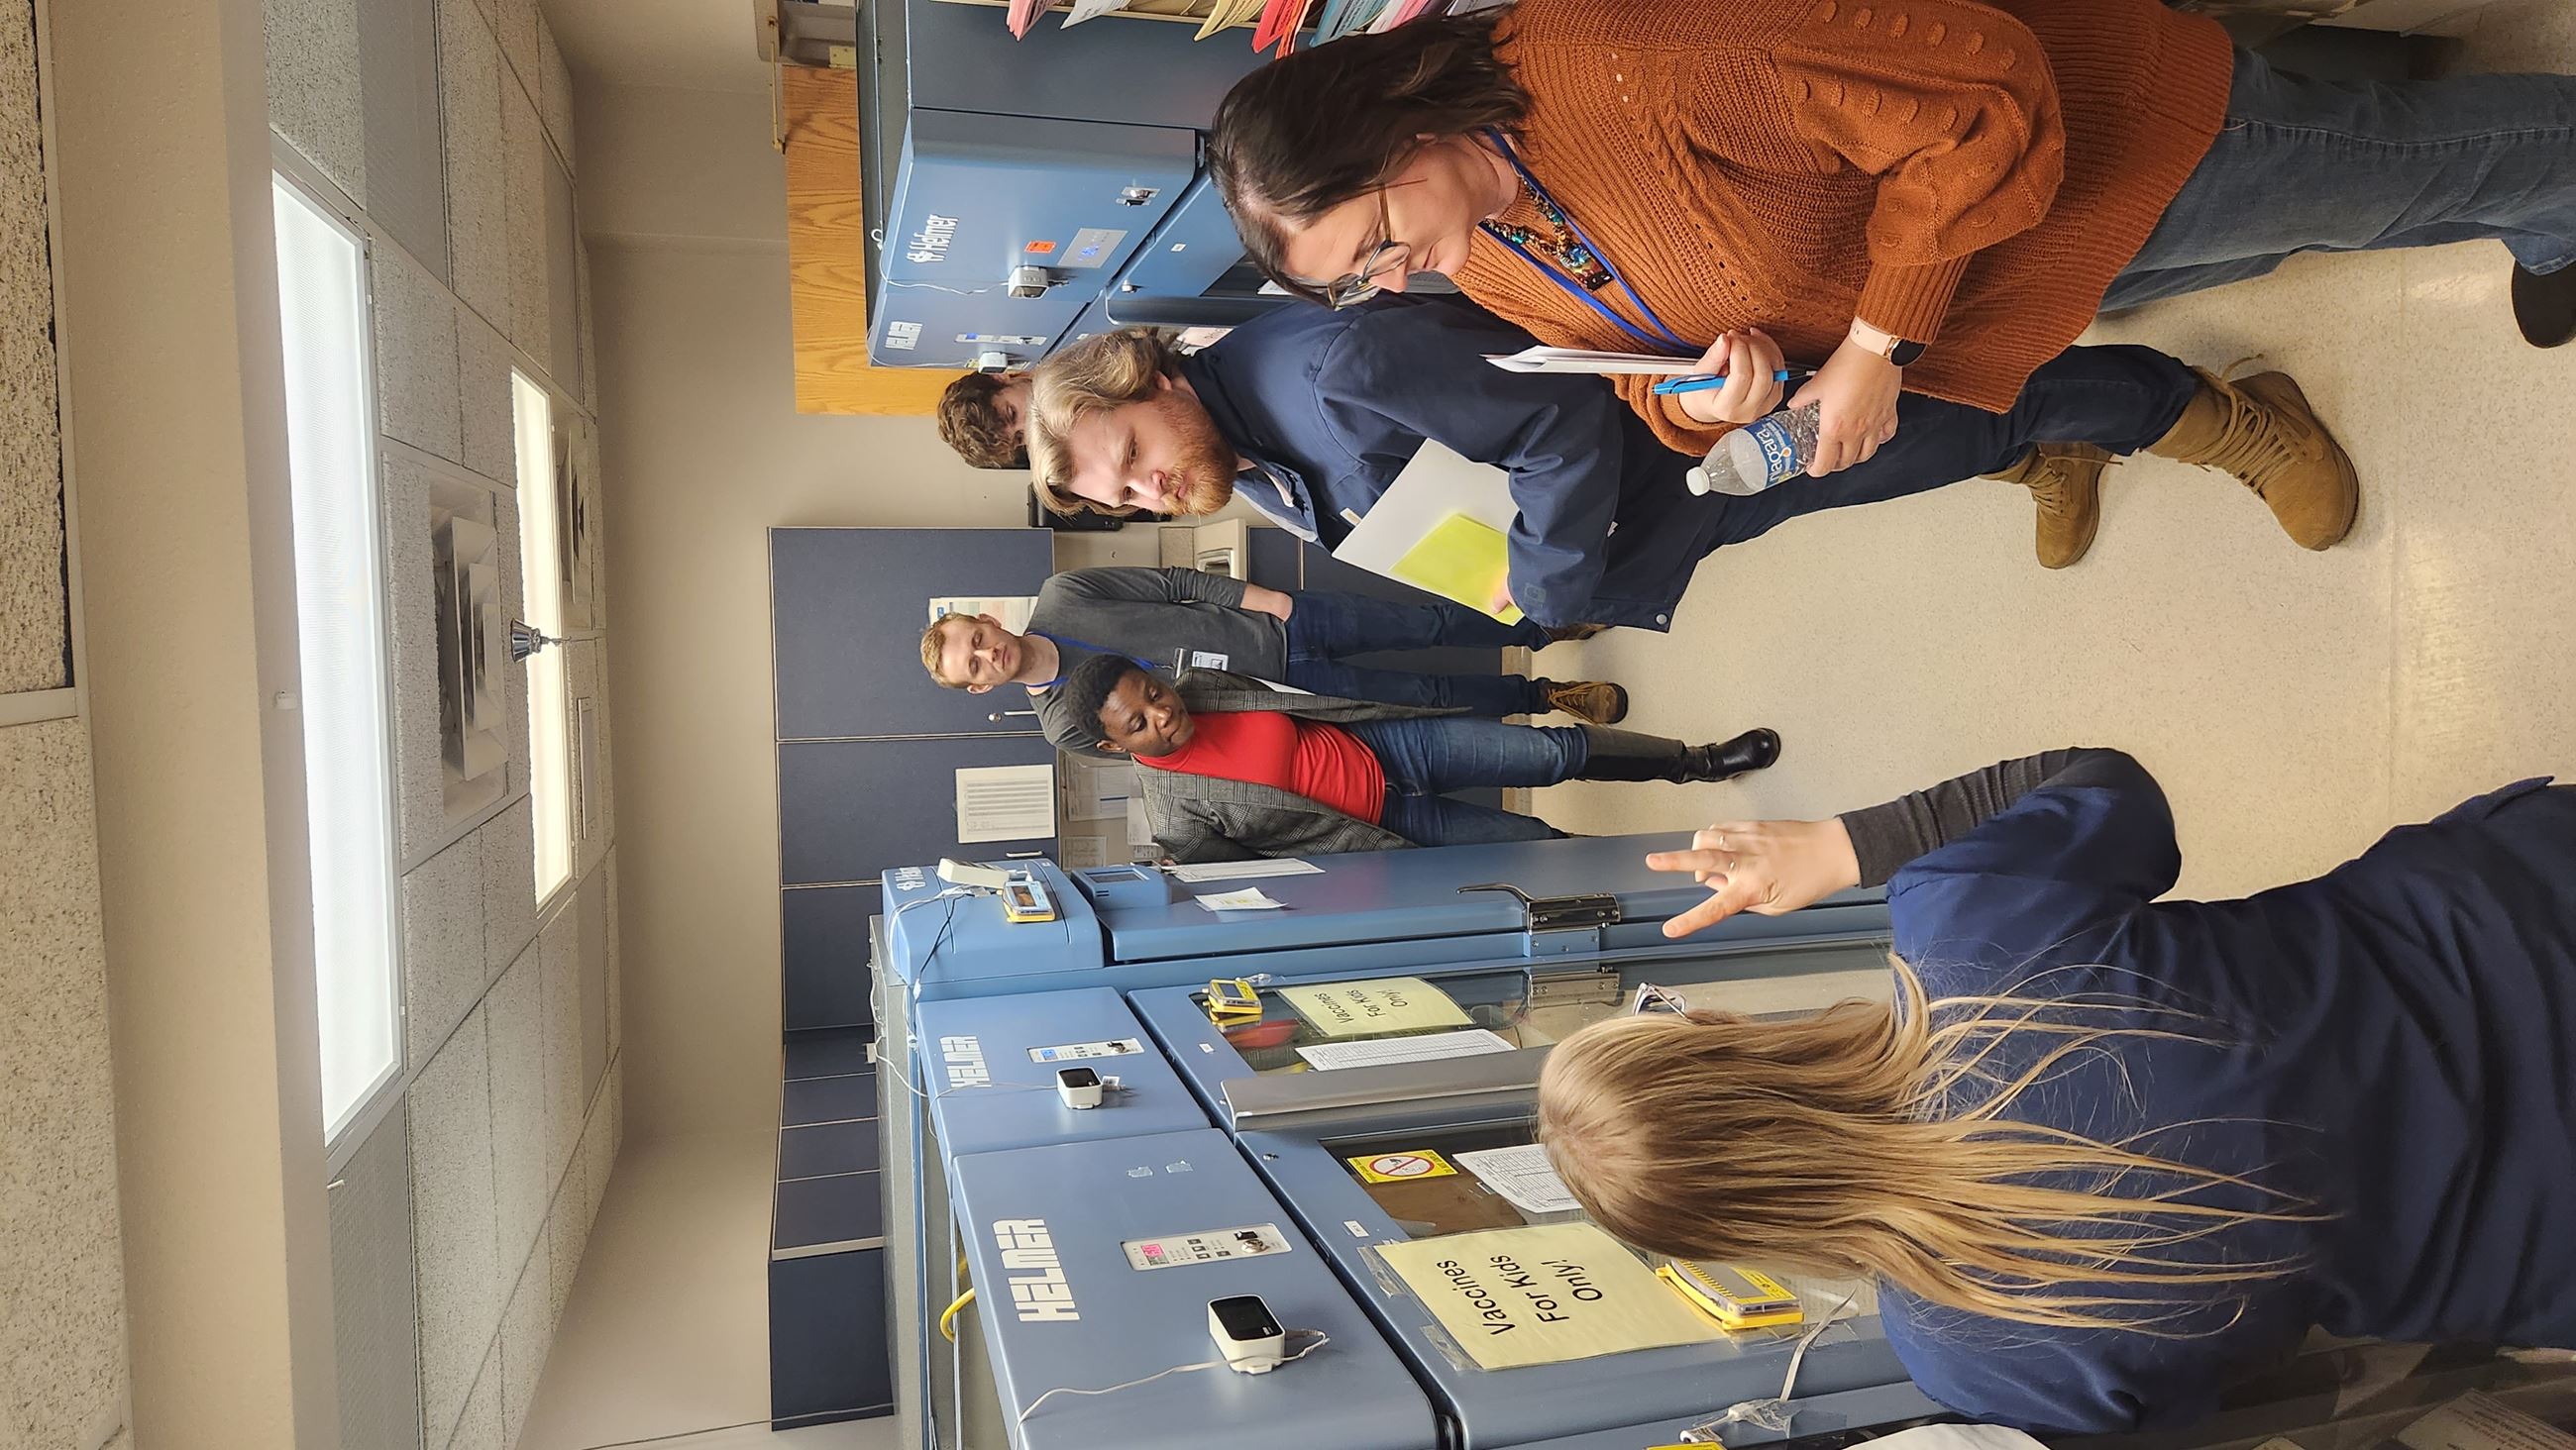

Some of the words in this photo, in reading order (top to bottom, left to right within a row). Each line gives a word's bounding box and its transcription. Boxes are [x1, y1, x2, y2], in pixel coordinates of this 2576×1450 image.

[909, 214, 958, 251] Helmer
[1314, 992, 1354, 1024] Vaccines
[1346, 990, 1371, 1004] Kids
[1363, 1004, 1386, 1017] For
[1376, 989, 1408, 1006] Only!
[939, 1036, 991, 1088] HELMER
[992, 1219, 1080, 1321] HELMER
[1489, 1255, 1538, 1289] Kids
[1541, 1259, 1603, 1301] Only!
[1436, 1260, 1516, 1335] Vaccines
[1525, 1292, 1569, 1322] For
